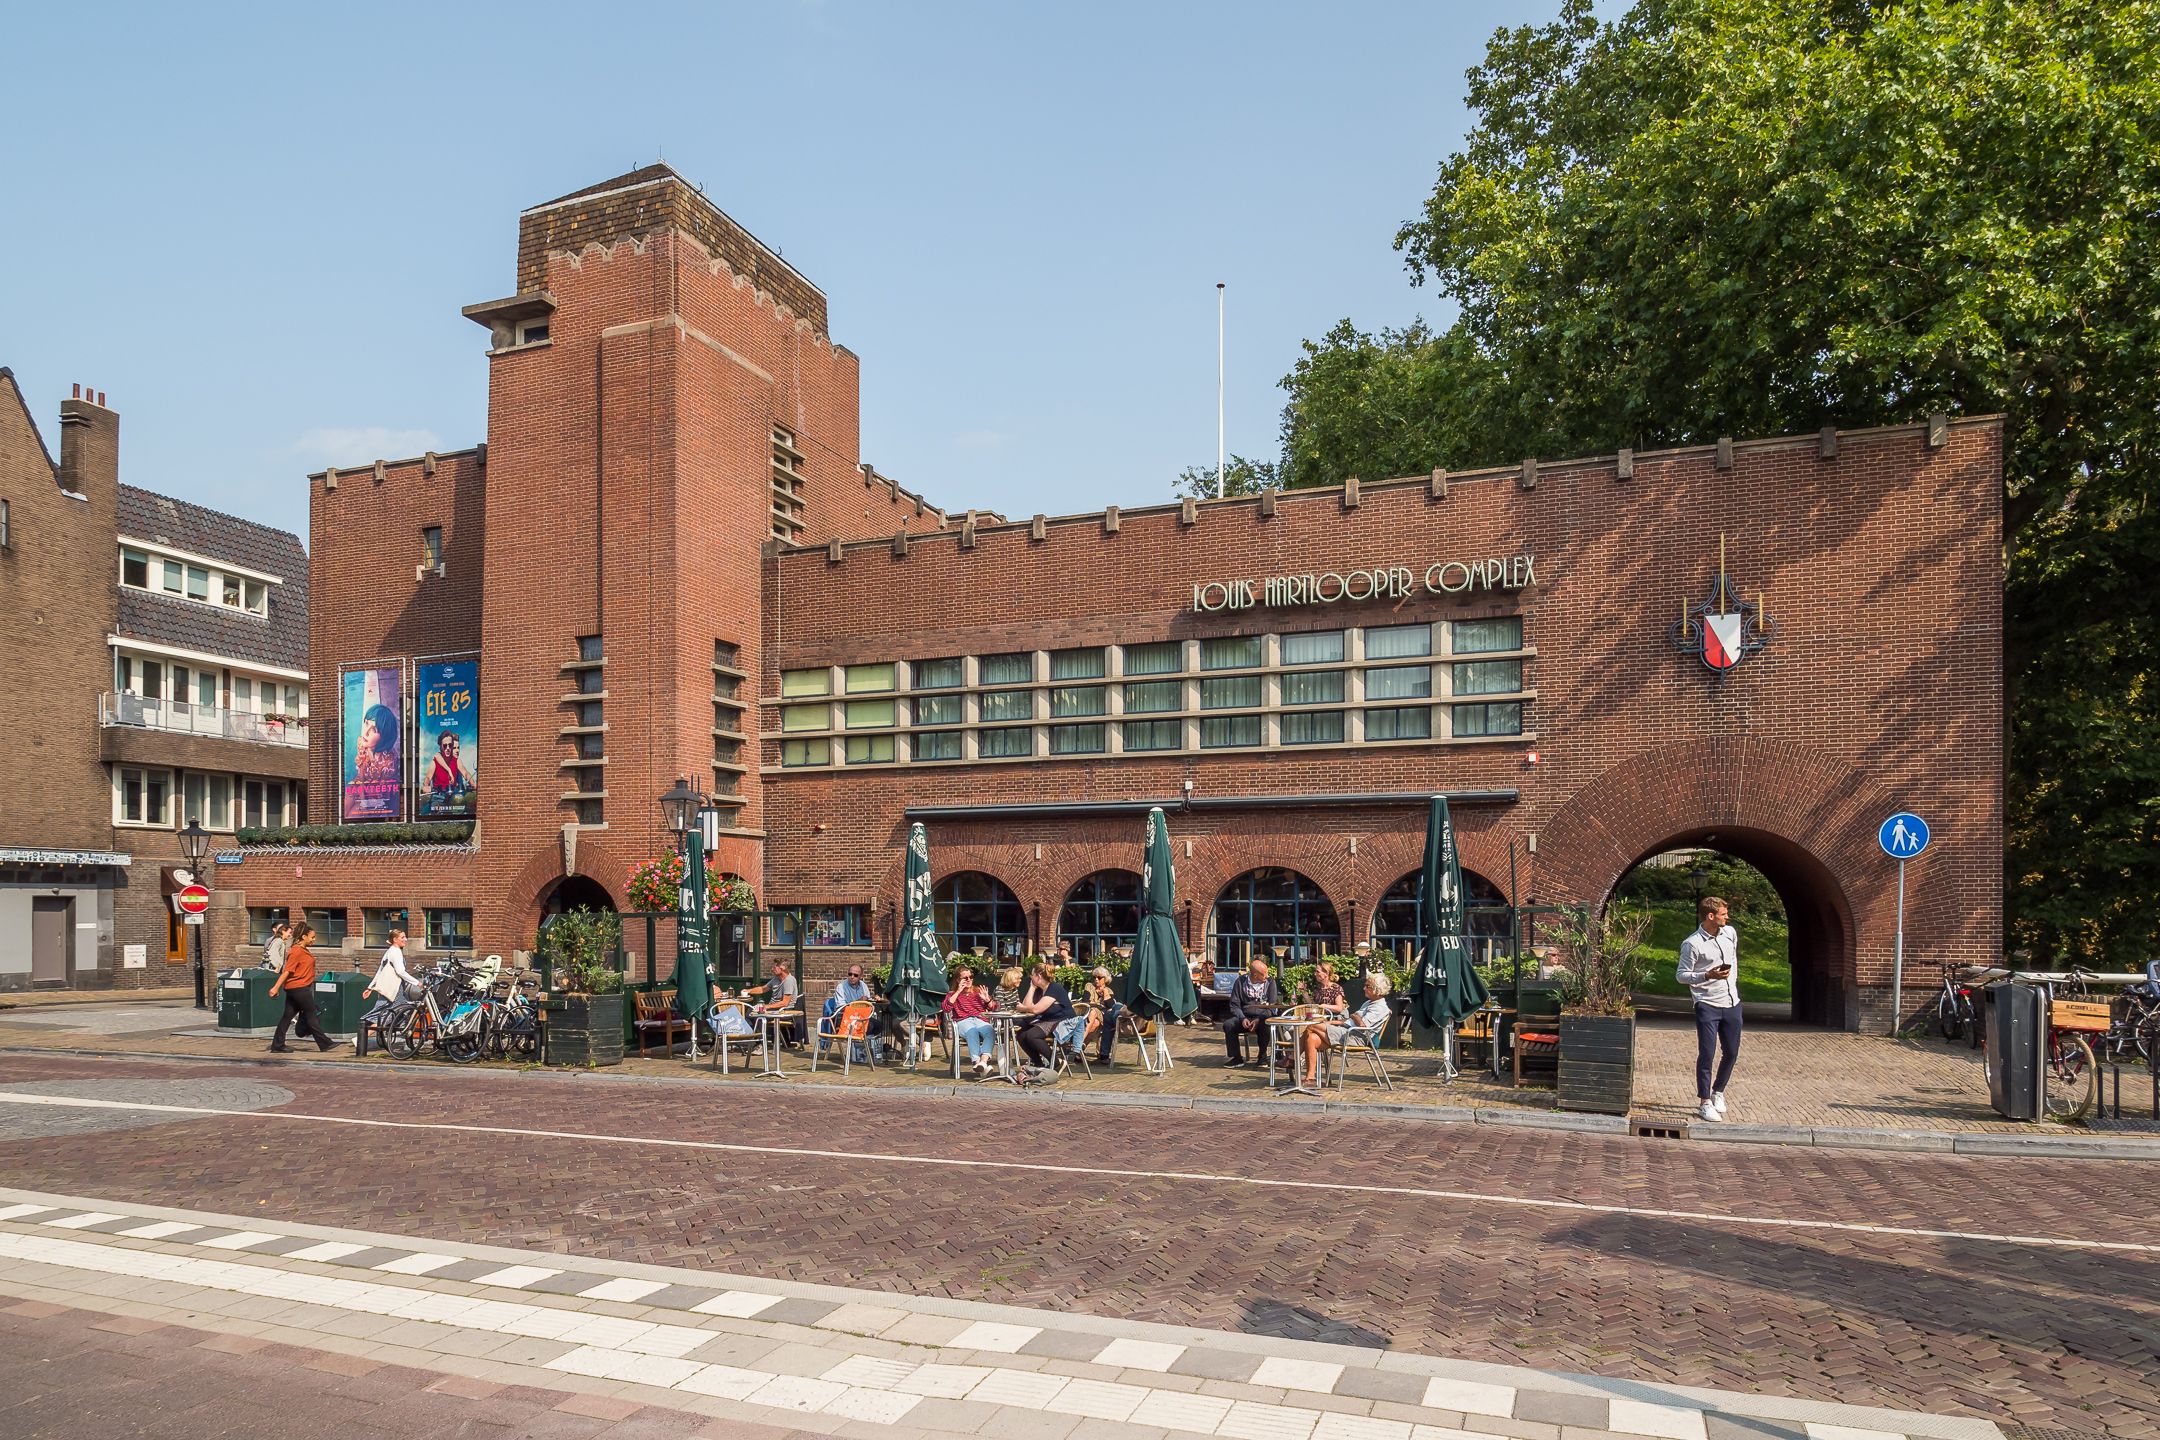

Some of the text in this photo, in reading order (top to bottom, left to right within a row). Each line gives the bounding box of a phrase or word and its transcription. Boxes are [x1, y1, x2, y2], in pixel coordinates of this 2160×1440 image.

[1194, 555, 1538, 612] LOUIS HARTLOOPER COMPLEX
[427, 689, 472, 716] ÉTÉ 85
[345, 784, 399, 795] BABYTEETH
